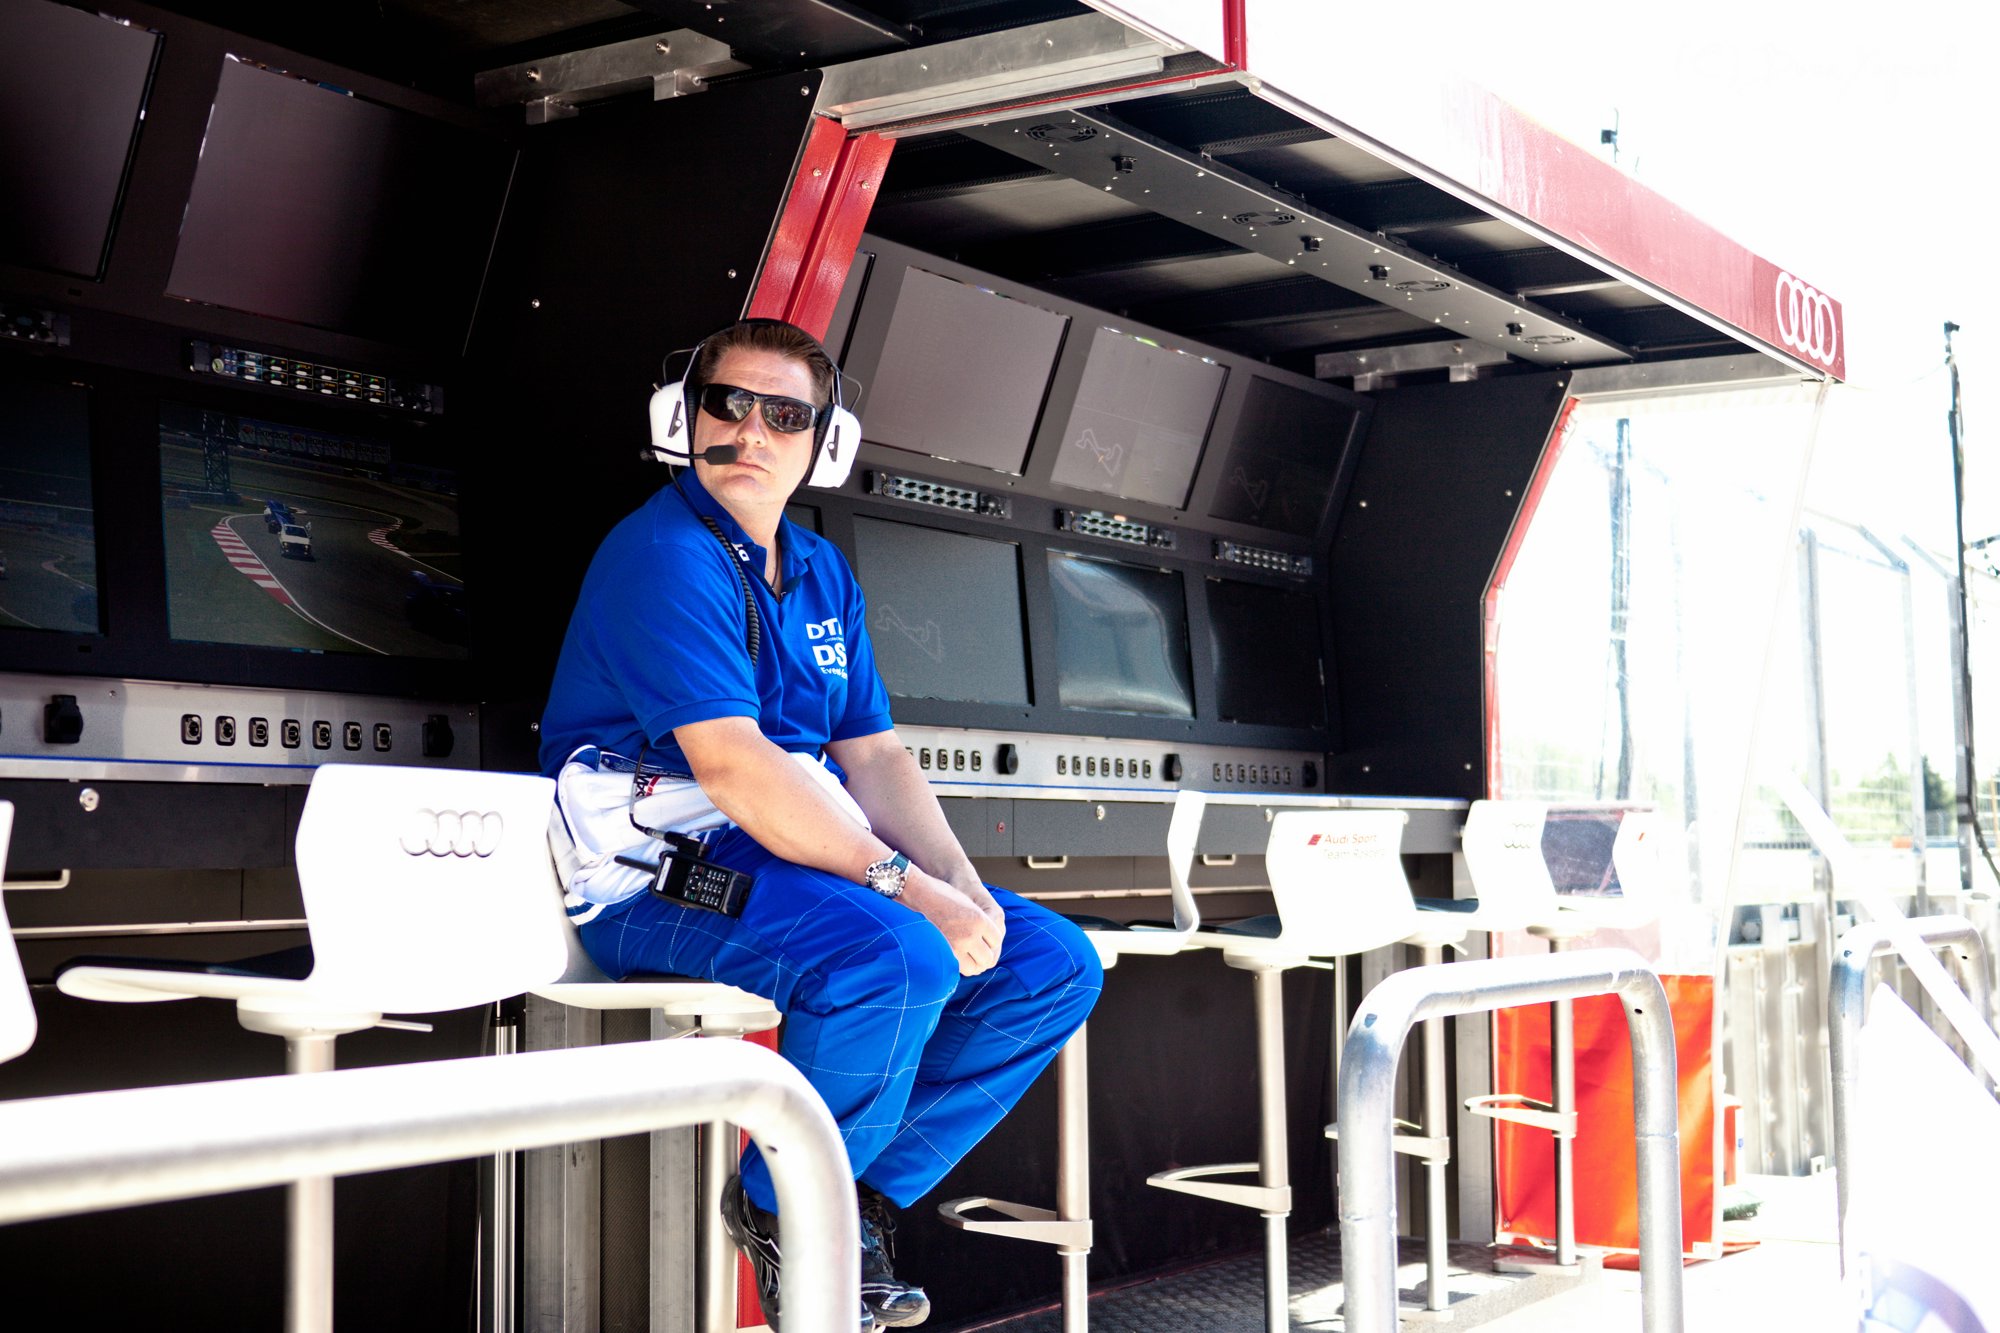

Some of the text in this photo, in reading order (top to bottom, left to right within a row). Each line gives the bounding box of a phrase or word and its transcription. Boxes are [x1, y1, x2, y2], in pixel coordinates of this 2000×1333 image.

[805, 617, 843, 640] DT
[1325, 833, 1377, 845] Audi Sport
